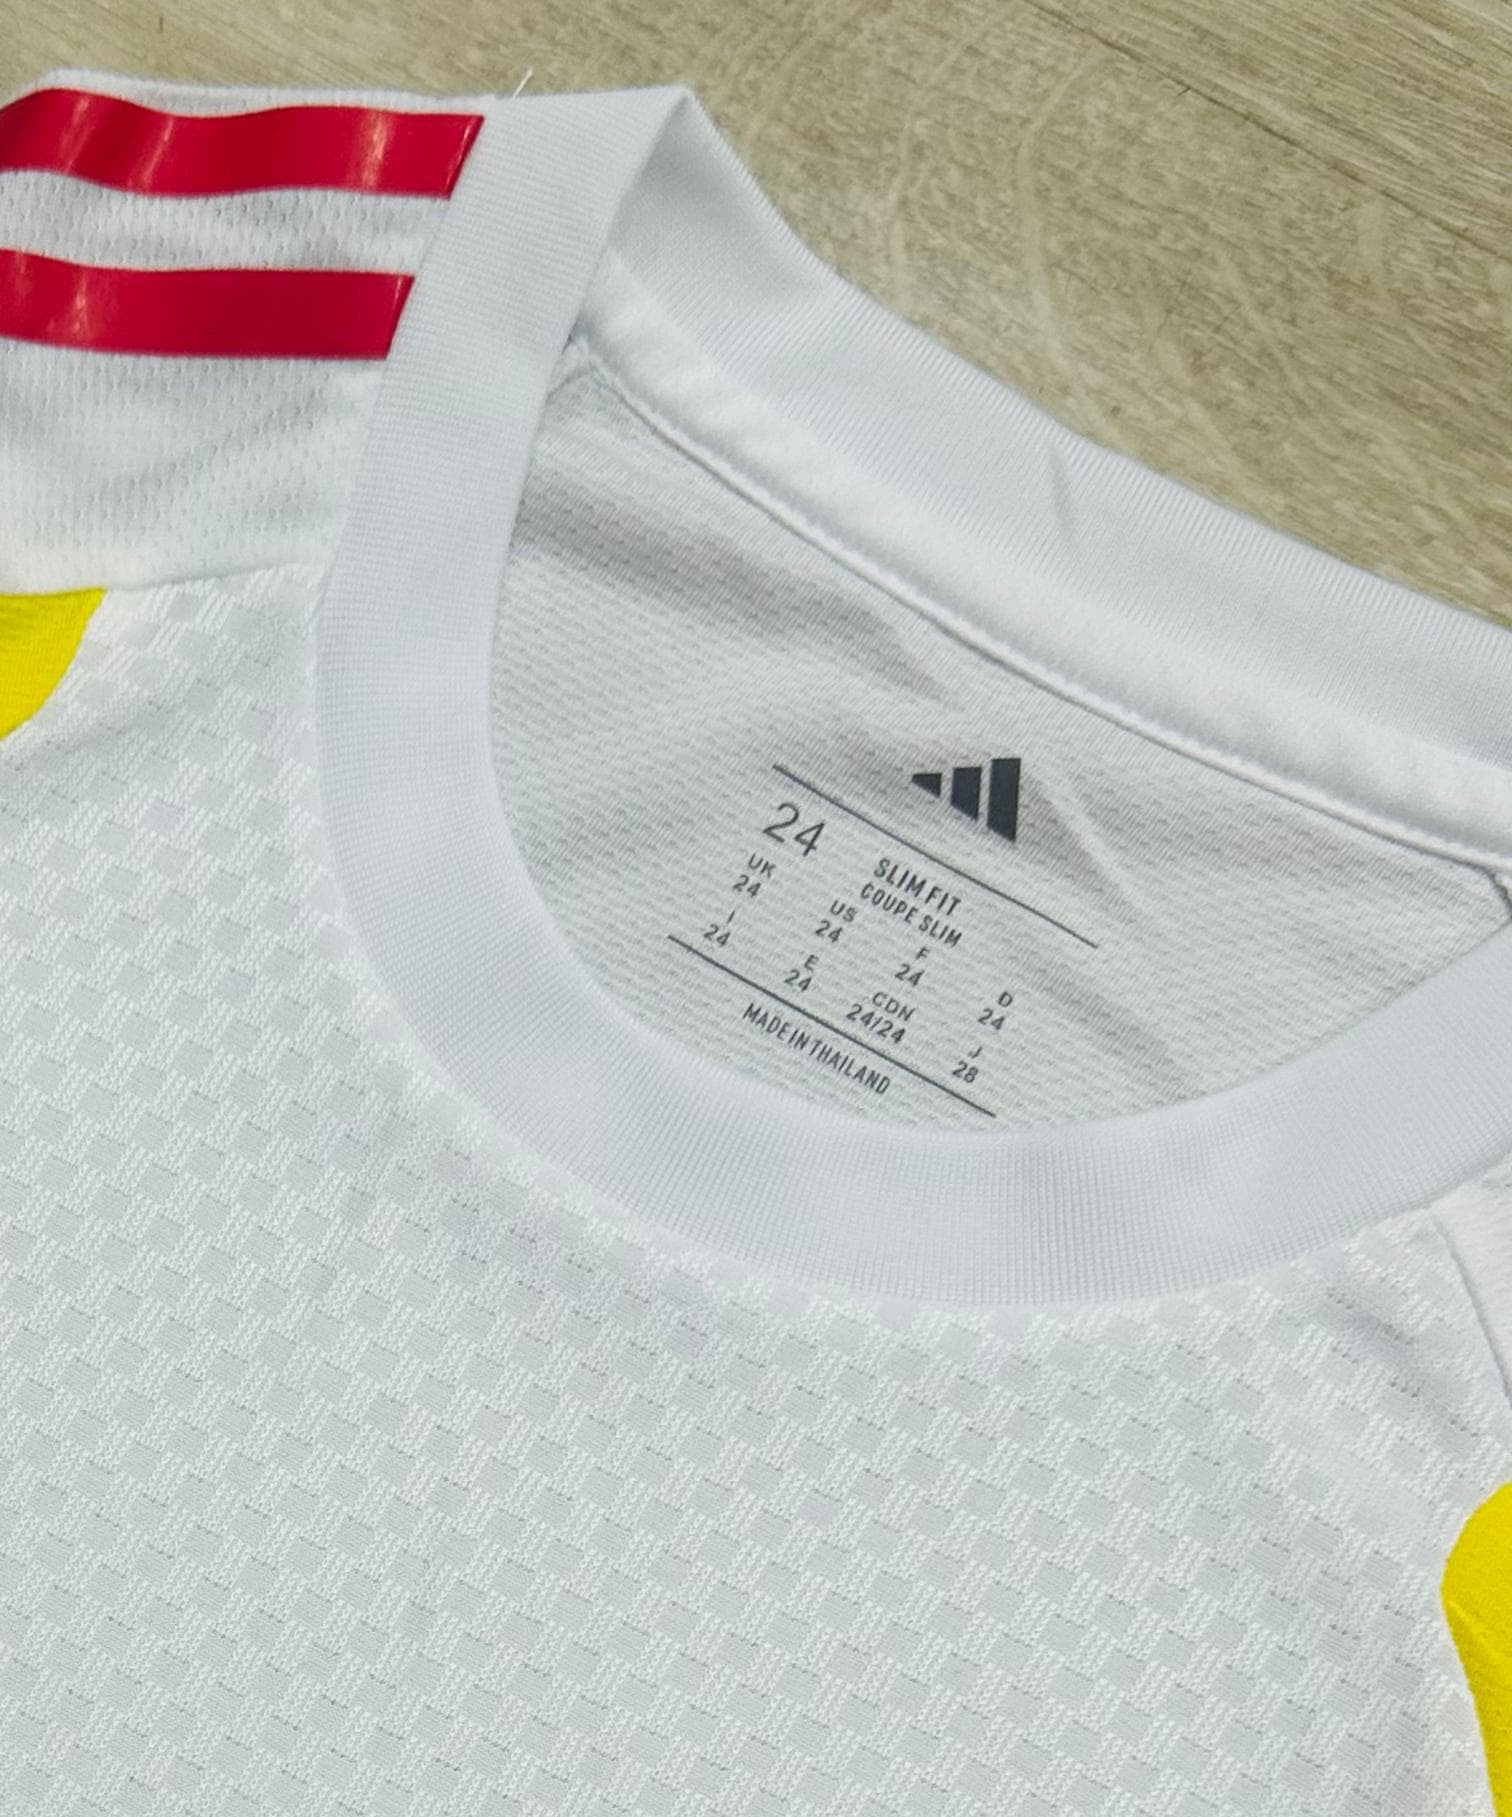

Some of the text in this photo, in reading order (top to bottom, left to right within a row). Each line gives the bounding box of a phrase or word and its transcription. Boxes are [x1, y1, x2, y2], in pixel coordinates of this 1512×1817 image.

[763, 803, 825, 857] 24
[748, 852, 1013, 1007] UK US F D
[861, 882, 962, 947] COUPE SLIM
[874, 858, 961, 916] SLIM FIT
[732, 874, 1005, 1030] 24 24 24 24
[703, 923, 979, 1083] 24 24 24/24 28
[743, 1003, 891, 1095] MADE IN THAILAND
[804, 954, 819, 971] E
[872, 992, 916, 1021] CDN
[968, 1046, 983, 1059] J
